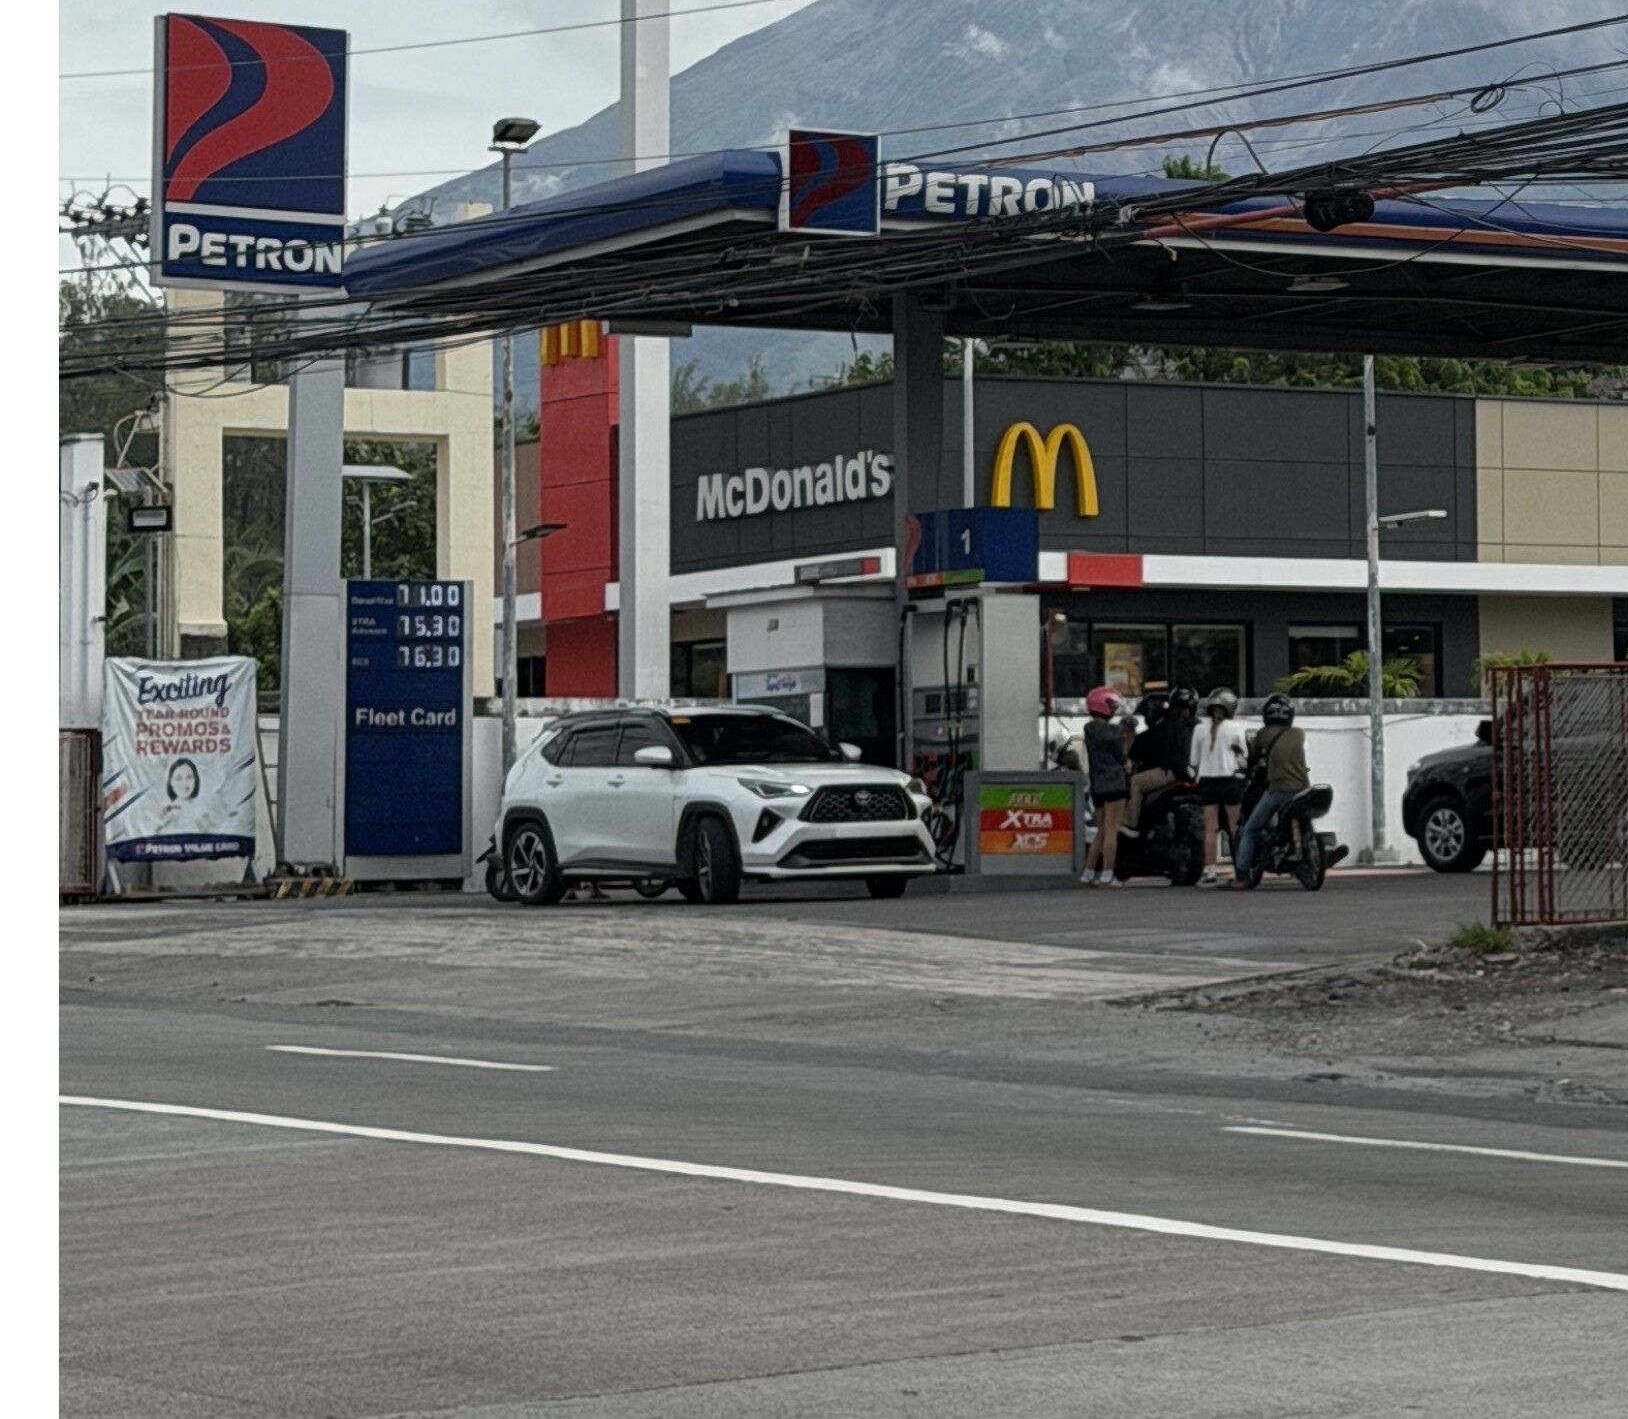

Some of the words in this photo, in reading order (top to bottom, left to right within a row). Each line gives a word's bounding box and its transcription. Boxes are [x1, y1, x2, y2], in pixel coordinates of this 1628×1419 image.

[883, 162, 1095, 217] PETRON
[168, 223, 342, 274] PETRON
[696, 450, 892, 521] McDonald's
[960, 528, 971, 555] 1
[137, 673, 232, 707] Exciting
[355, 707, 405, 726] Fleet
[410, 707, 456, 726] Card
[136, 737, 232, 756] REWARDS
